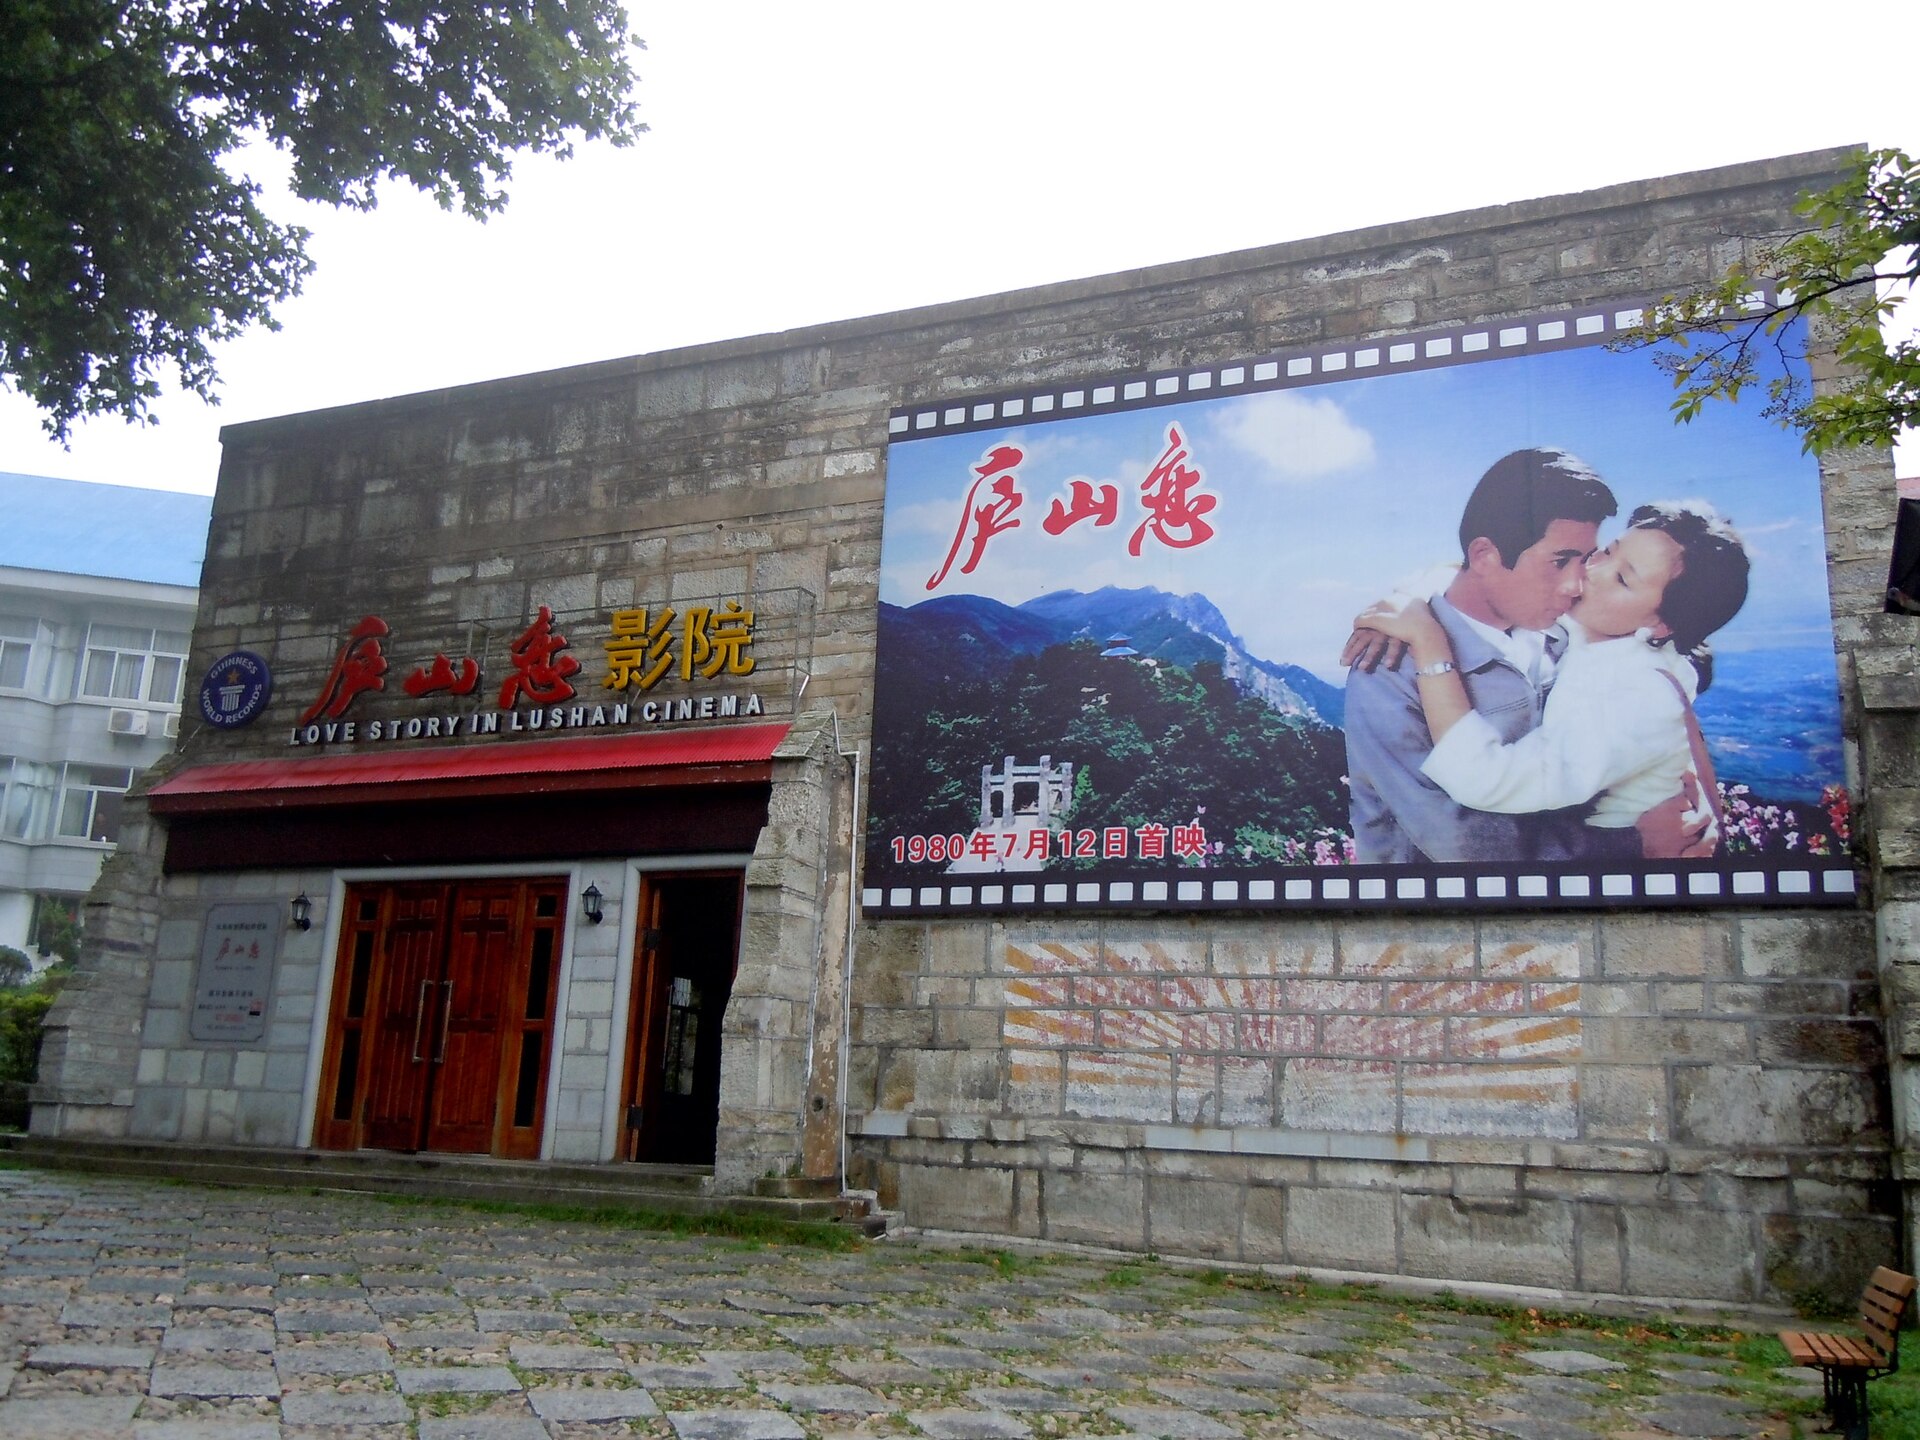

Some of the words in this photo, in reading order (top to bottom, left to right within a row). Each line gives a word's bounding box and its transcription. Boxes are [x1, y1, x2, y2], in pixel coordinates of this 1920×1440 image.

[210, 656, 258, 679] GUINNESS
[202, 687, 223, 723] WORLD
[225, 683, 262, 724] RECORDS
[290, 722, 356, 745] LOVE
[370, 716, 460, 740] STORY
[471, 712, 498, 733] IN
[511, 703, 628, 731] LUSHAN
[642, 693, 762, 722] CINEMA
[891, 823, 1206, 863] 1980年7月12日首映
